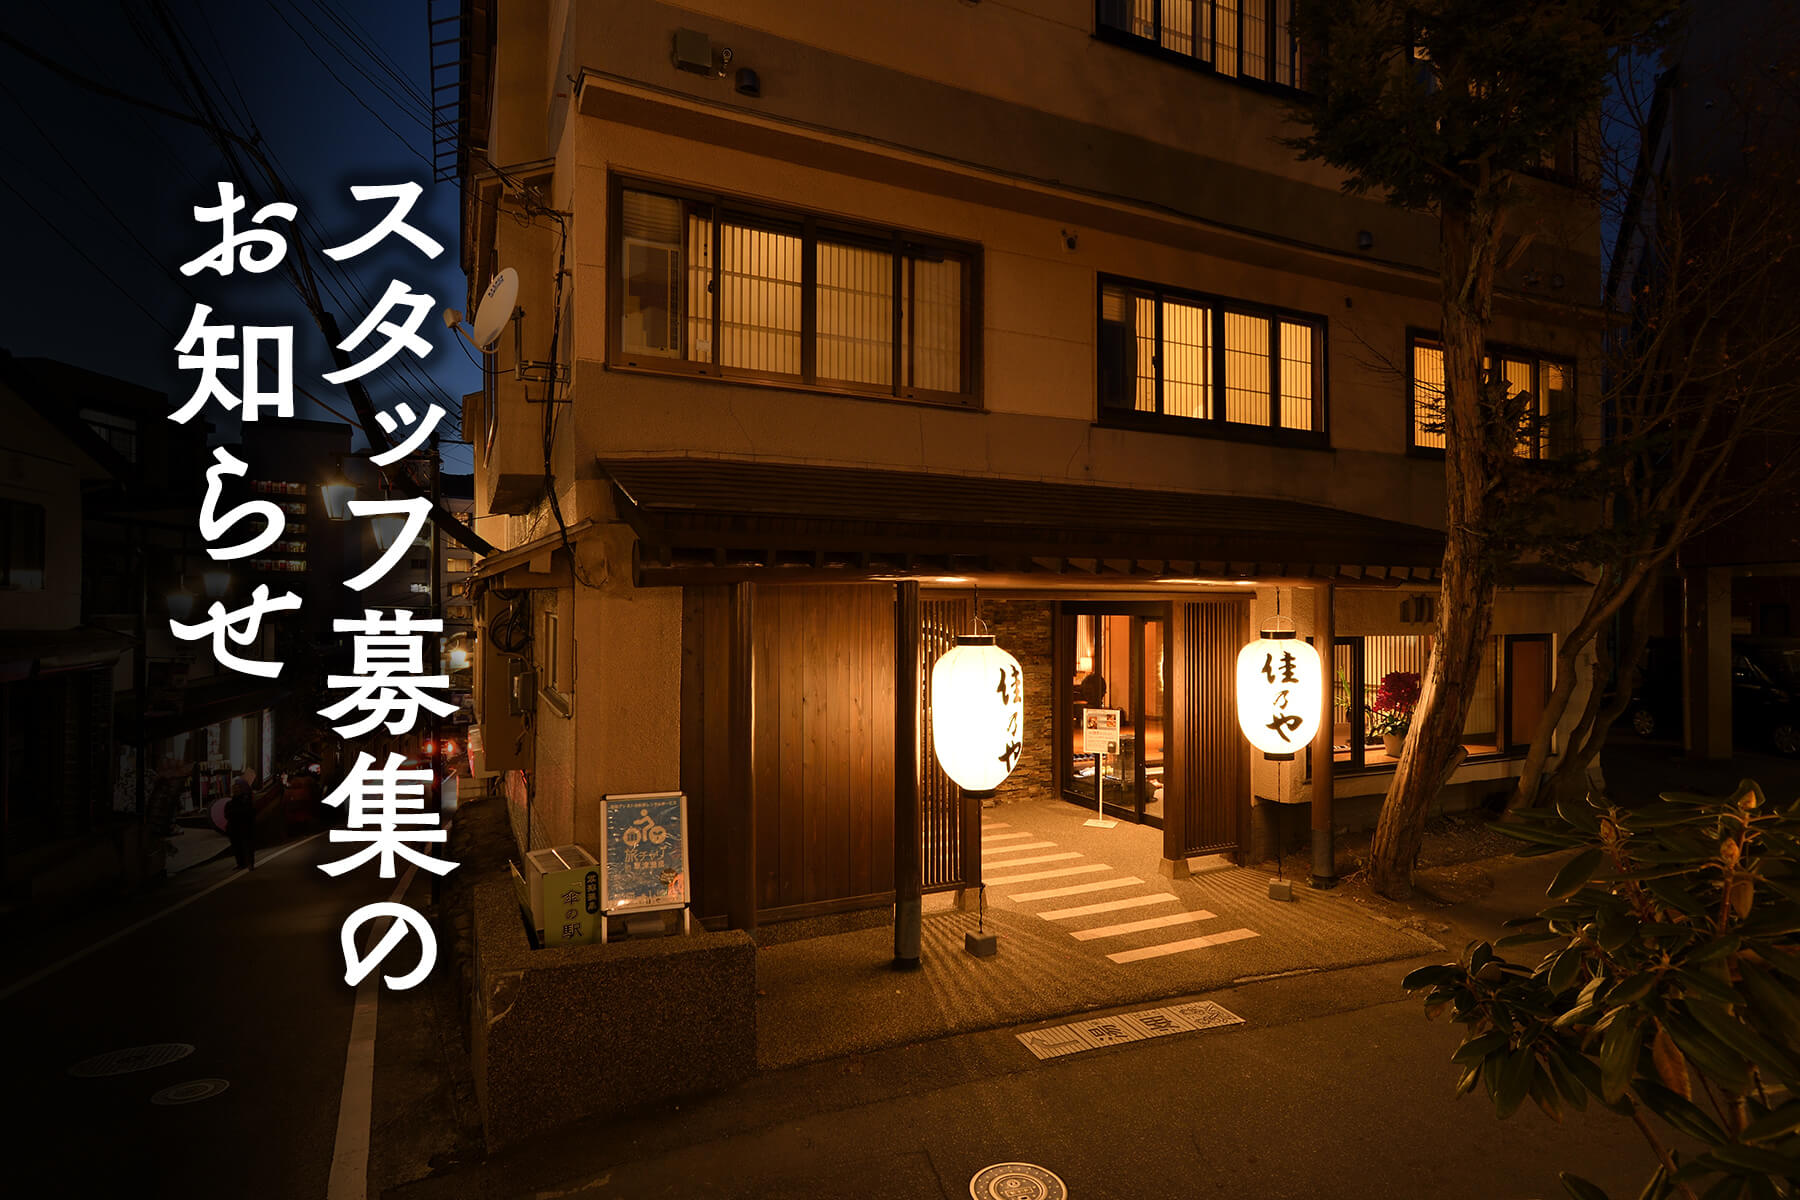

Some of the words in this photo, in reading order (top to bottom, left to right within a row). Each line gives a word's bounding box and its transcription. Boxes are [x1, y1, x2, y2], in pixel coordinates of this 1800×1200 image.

[1261, 650, 1303, 743] 佳乃や
[562, 889, 583, 938] 傘の駅
[1088, 1014, 1181, 1042] 湯畑
